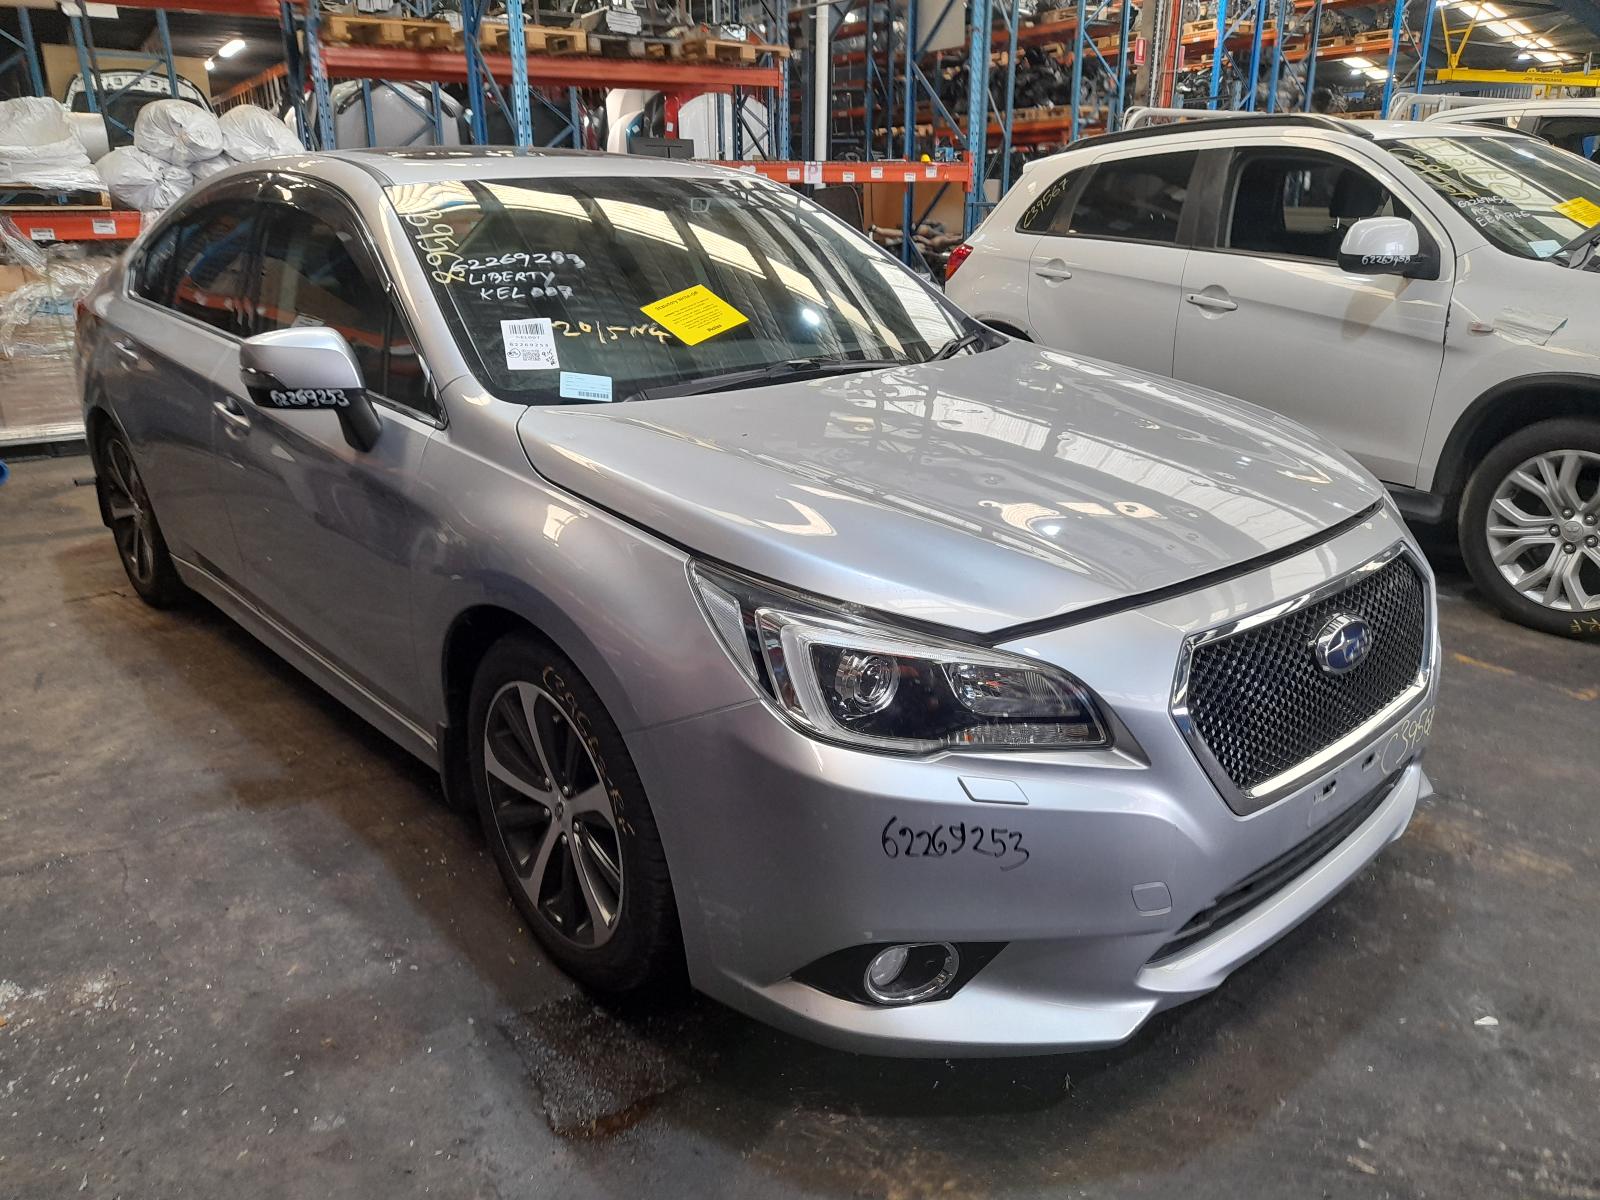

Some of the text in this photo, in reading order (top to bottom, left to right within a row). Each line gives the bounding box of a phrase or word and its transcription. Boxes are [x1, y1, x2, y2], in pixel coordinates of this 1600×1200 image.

[1023, 177, 1068, 229] C39567
[468, 271, 556, 289] LIBERTY
[269, 388, 350, 407] 62269253
[881, 816, 1030, 873] 62269253
